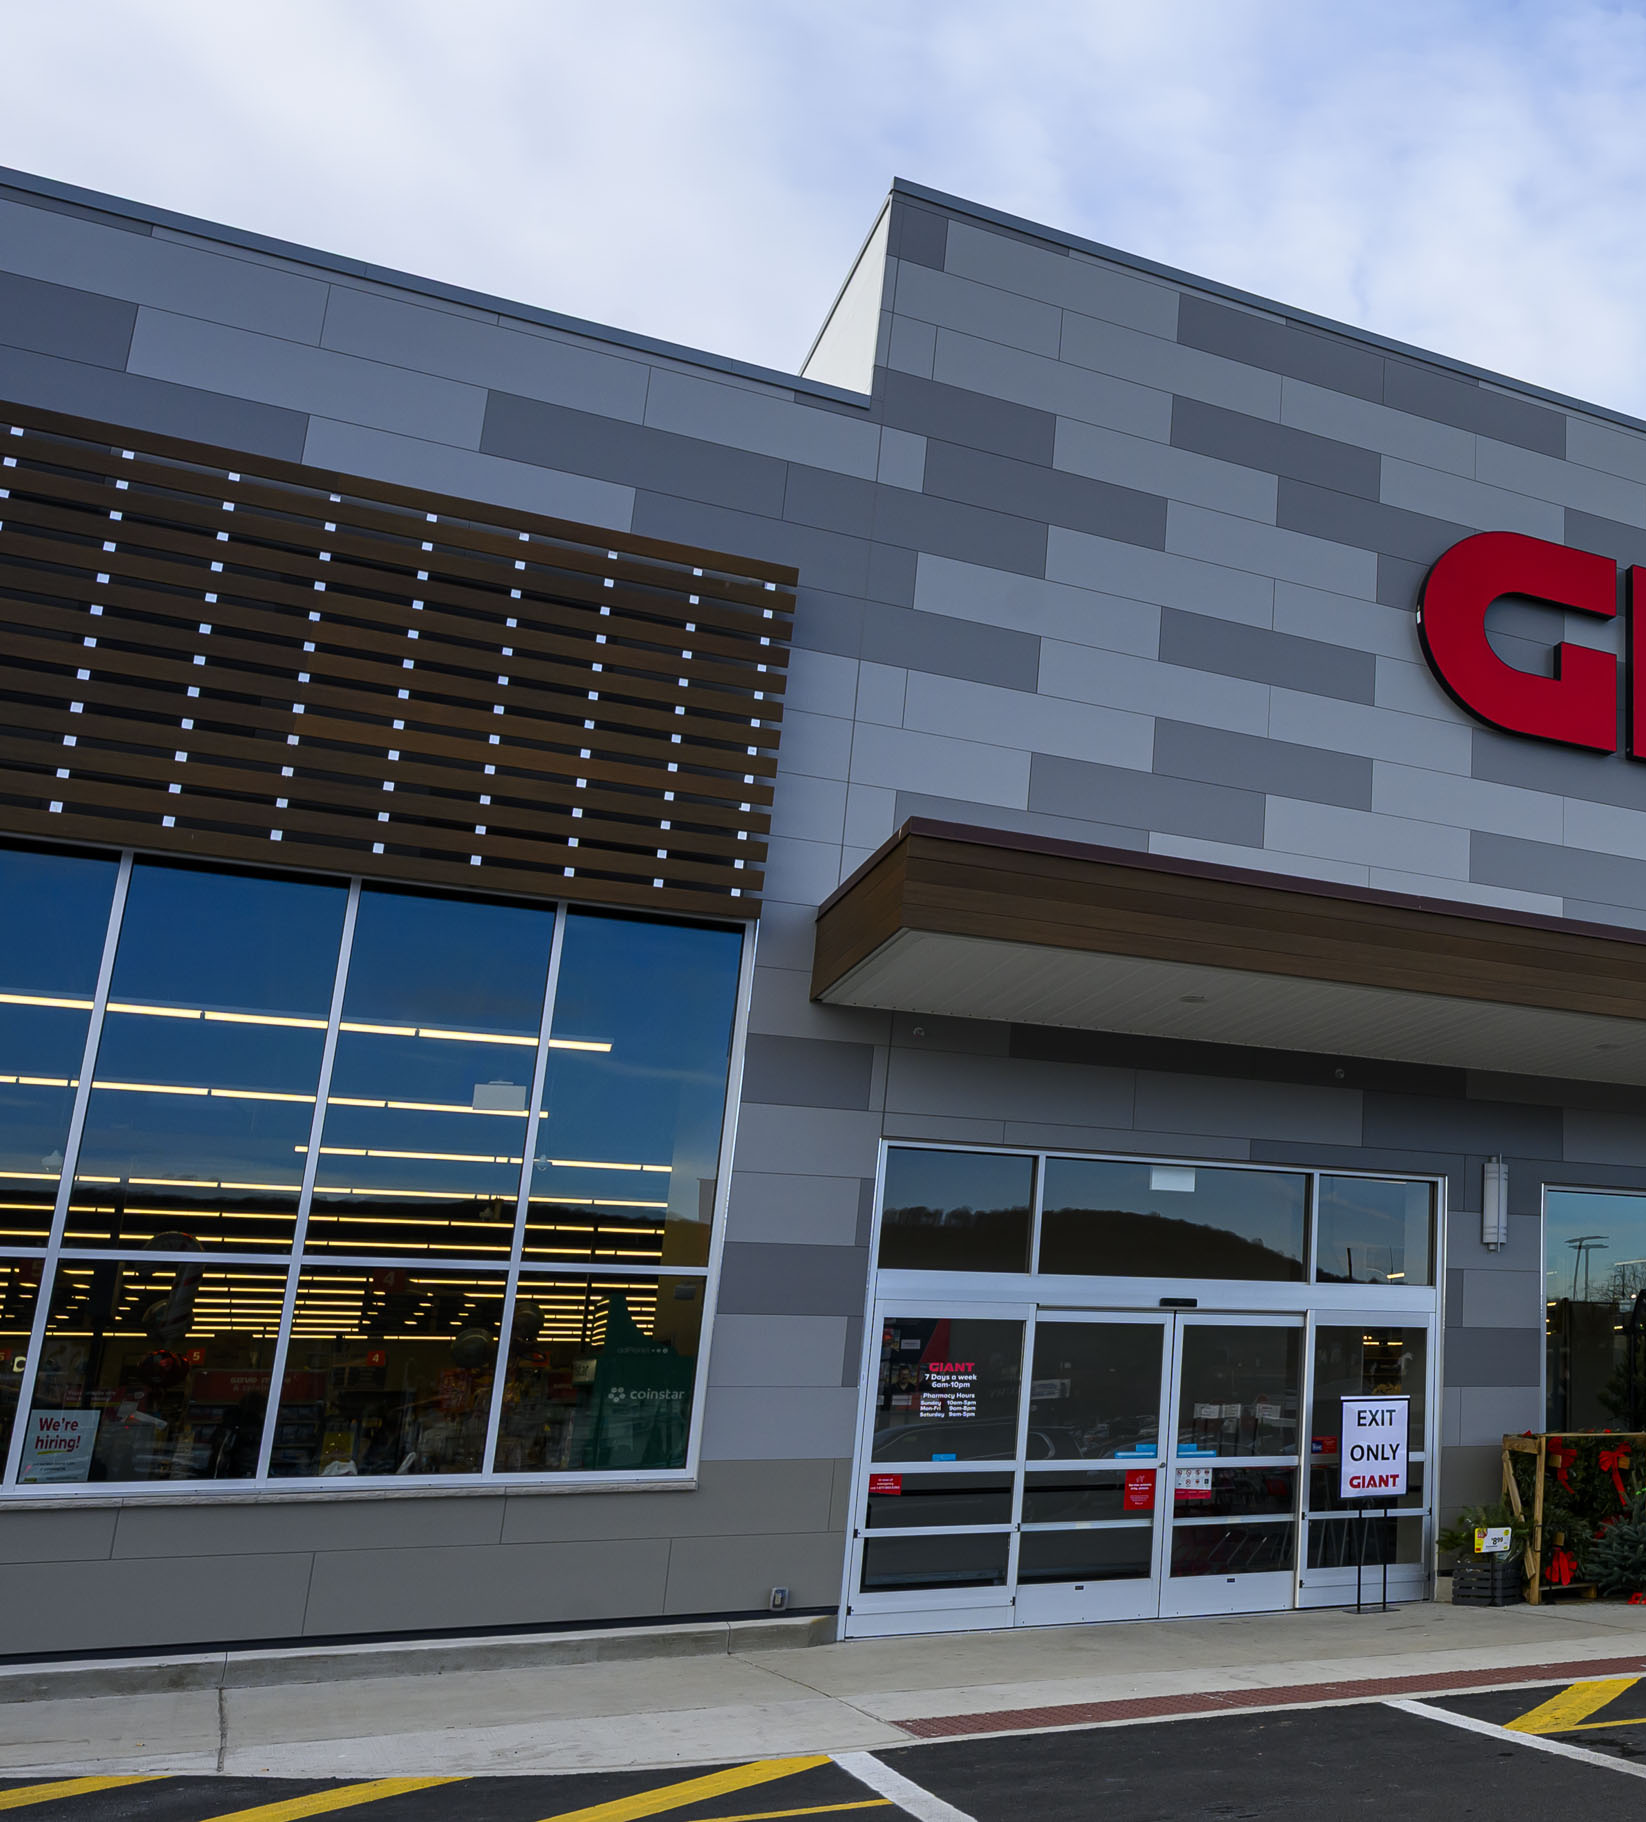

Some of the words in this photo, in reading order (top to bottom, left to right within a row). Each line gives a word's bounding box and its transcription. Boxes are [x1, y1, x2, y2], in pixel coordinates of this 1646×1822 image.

[371, 1353, 380, 1363] 4
[928, 1362, 976, 1372] GIANT
[931, 1373, 950, 1381] Days
[931, 1381, 971, 1389] 6am-10pm
[629, 1387, 685, 1400] coinstar
[39, 1417, 79, 1431] We're
[1357, 1409, 1396, 1427] EXIT
[34, 1434, 81, 1452] hiring!
[1350, 1443, 1400, 1462] ONLY
[1349, 1474, 1400, 1489] GIANT
